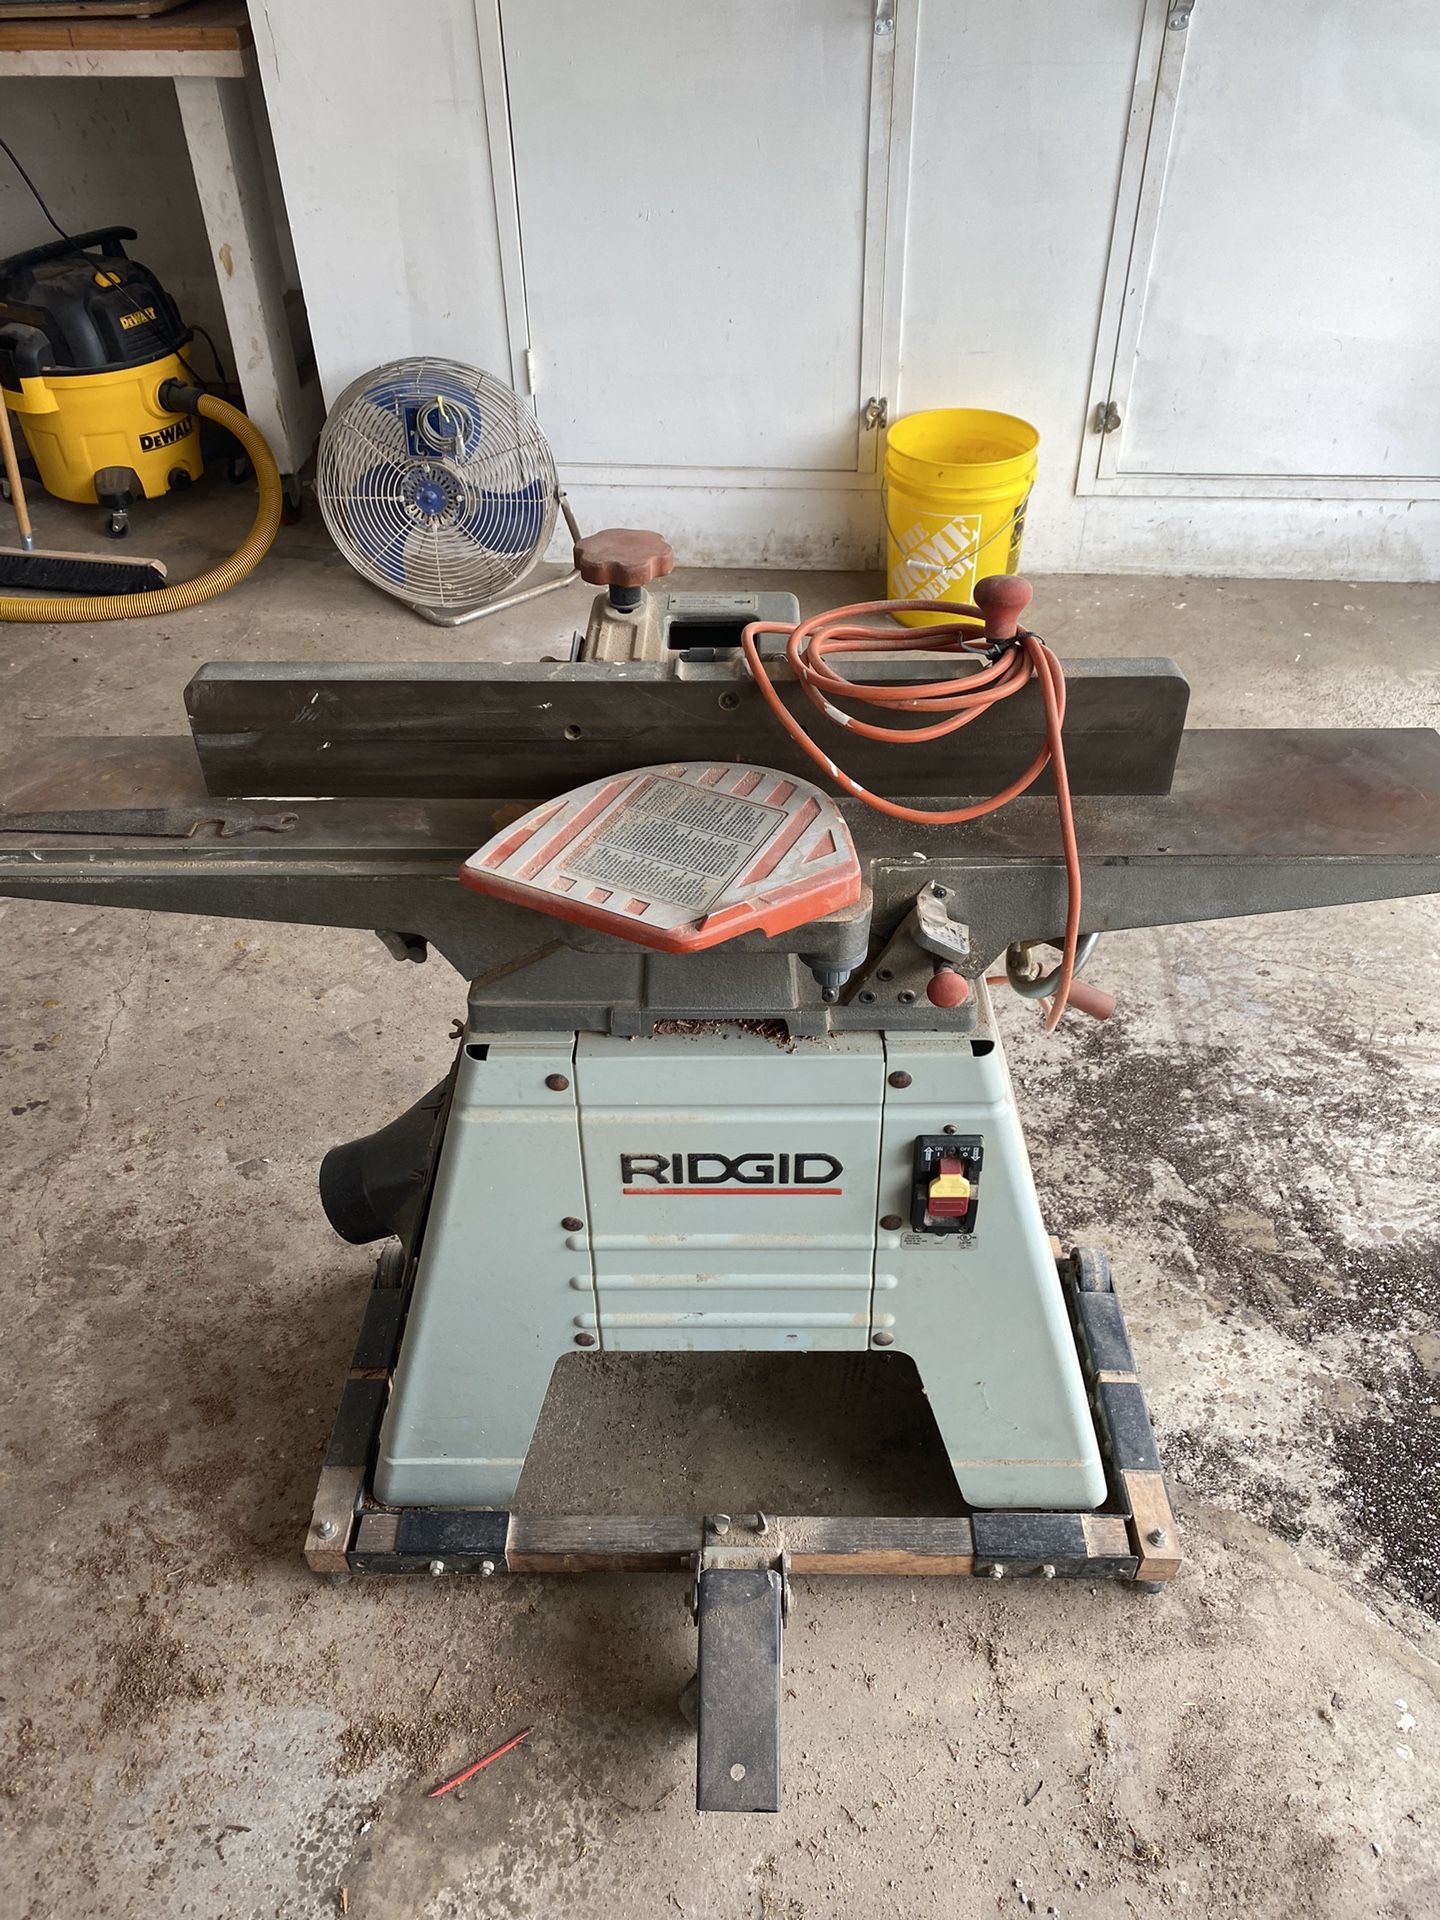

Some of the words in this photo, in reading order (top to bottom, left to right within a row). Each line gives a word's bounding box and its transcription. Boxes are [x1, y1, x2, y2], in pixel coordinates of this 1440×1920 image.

[139, 416, 193, 450] DEWALT
[892, 517, 979, 600] HOME
[915, 553, 974, 600] DEPOT
[620, 1153, 843, 1184] RIDGID
